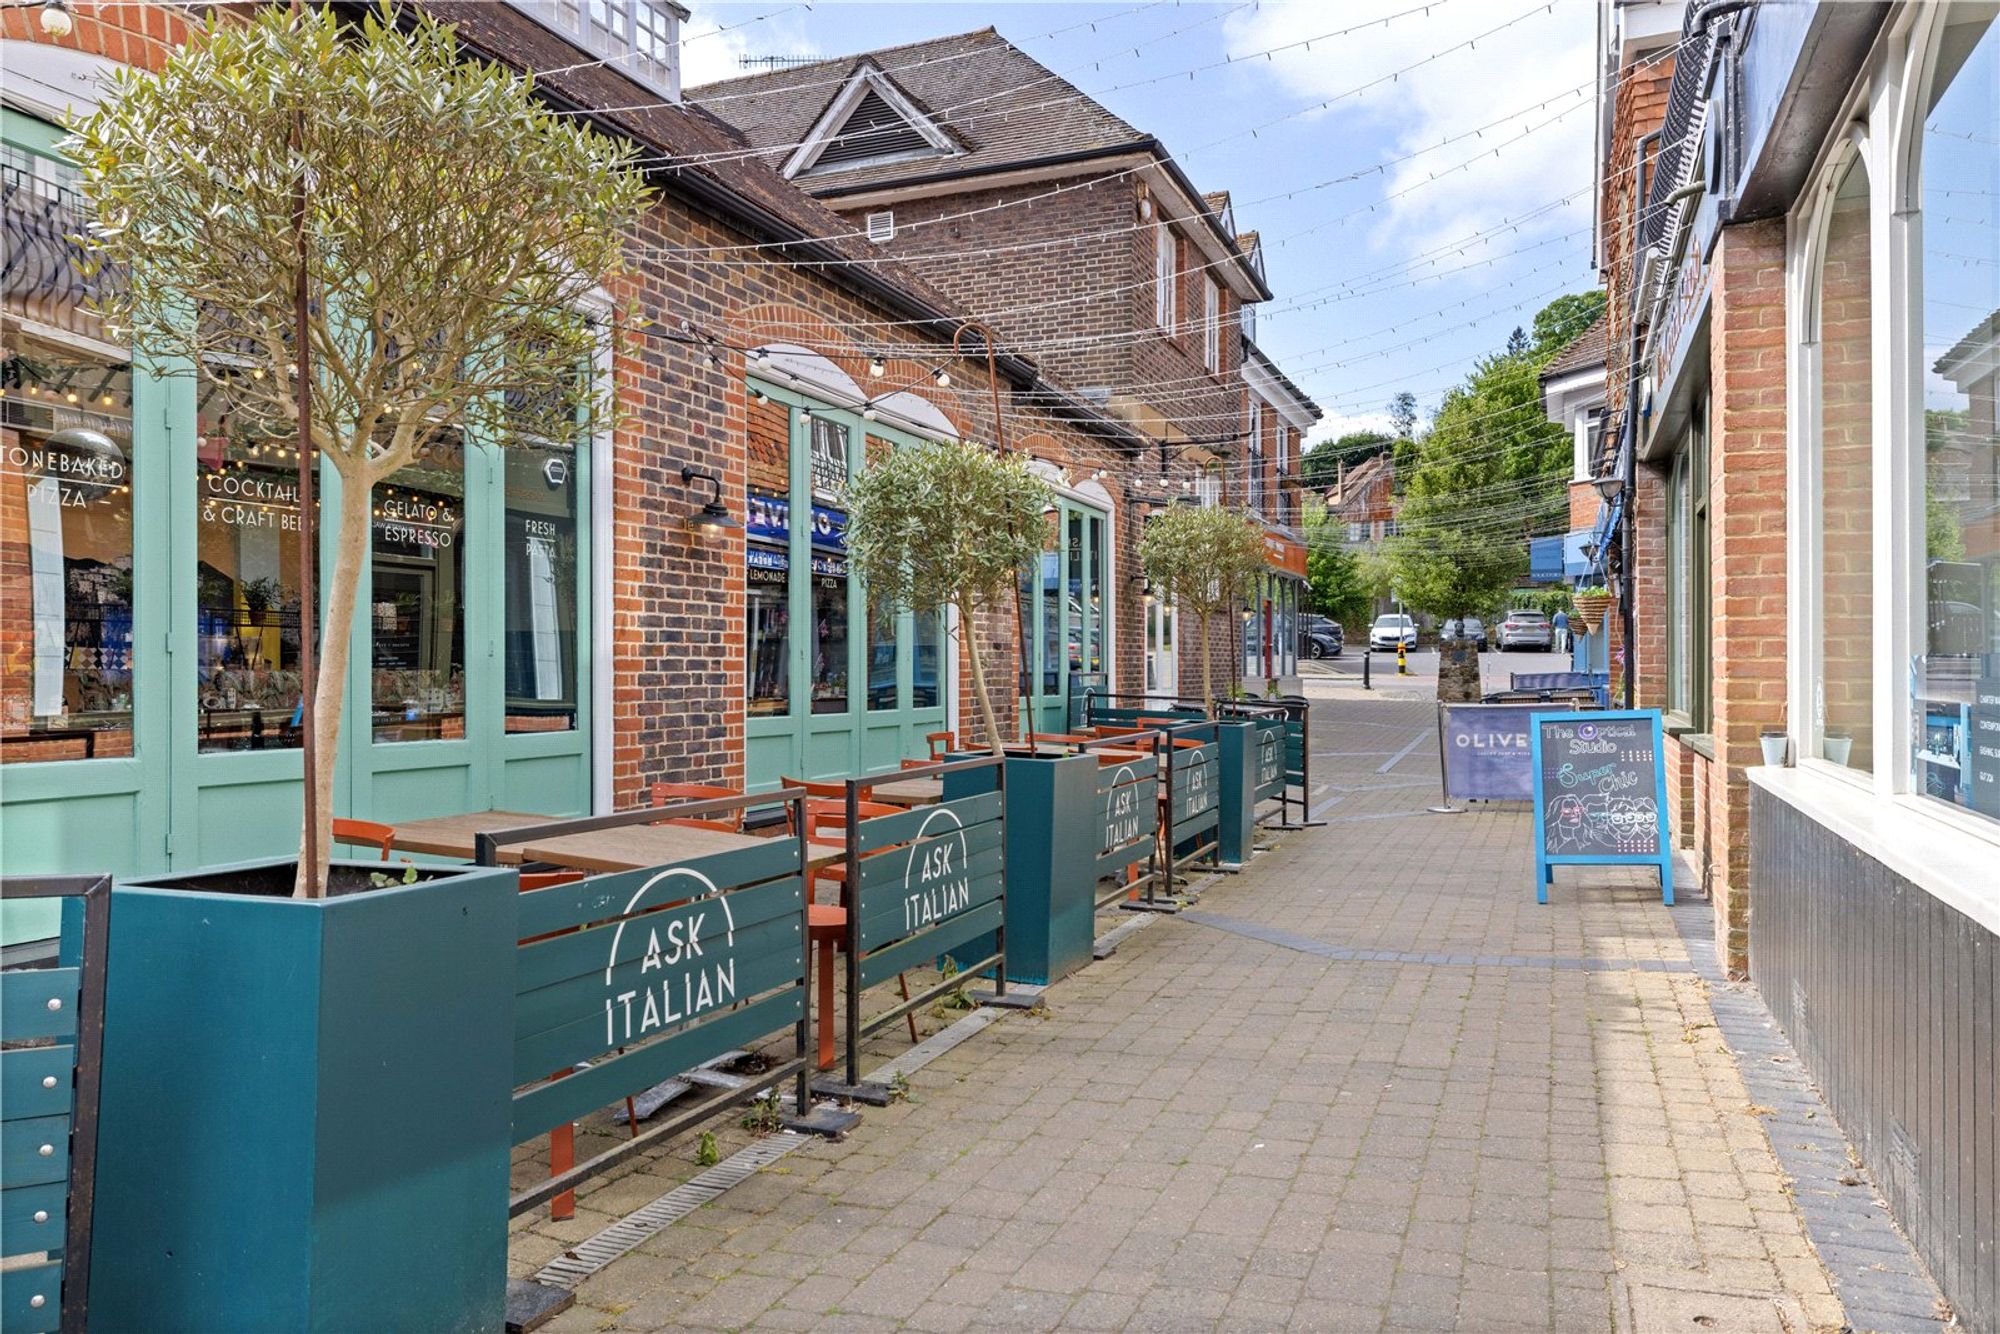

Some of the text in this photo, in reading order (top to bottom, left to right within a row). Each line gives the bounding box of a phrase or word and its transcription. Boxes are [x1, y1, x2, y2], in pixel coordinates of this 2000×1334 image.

[27, 483, 87, 508] PIZZA
[208, 475, 302, 502] COCKTAIL
[203, 505, 313, 534] & CRAFT BEE
[384, 500, 454, 521] GELATO &
[385, 526, 451, 547] ESPRESSO
[525, 520, 555, 536] FRESH
[750, 569, 785, 583] LEMONADE
[821, 577, 837, 589] PIZZA
[1456, 733, 1528, 748] OLIVE
[1542, 724, 1574, 739] The
[1569, 738, 1617, 755] Studio
[1556, 762, 1617, 786] Super
[1598, 770, 1638, 795] Chic
[1114, 791, 1131, 817] ASK
[1105, 815, 1138, 848] ITALIAN
[922, 843, 953, 883] ASK
[905, 877, 968, 930] ITALIAN
[641, 913, 705, 974] ASK
[606, 958, 735, 1045] ITALIAN
